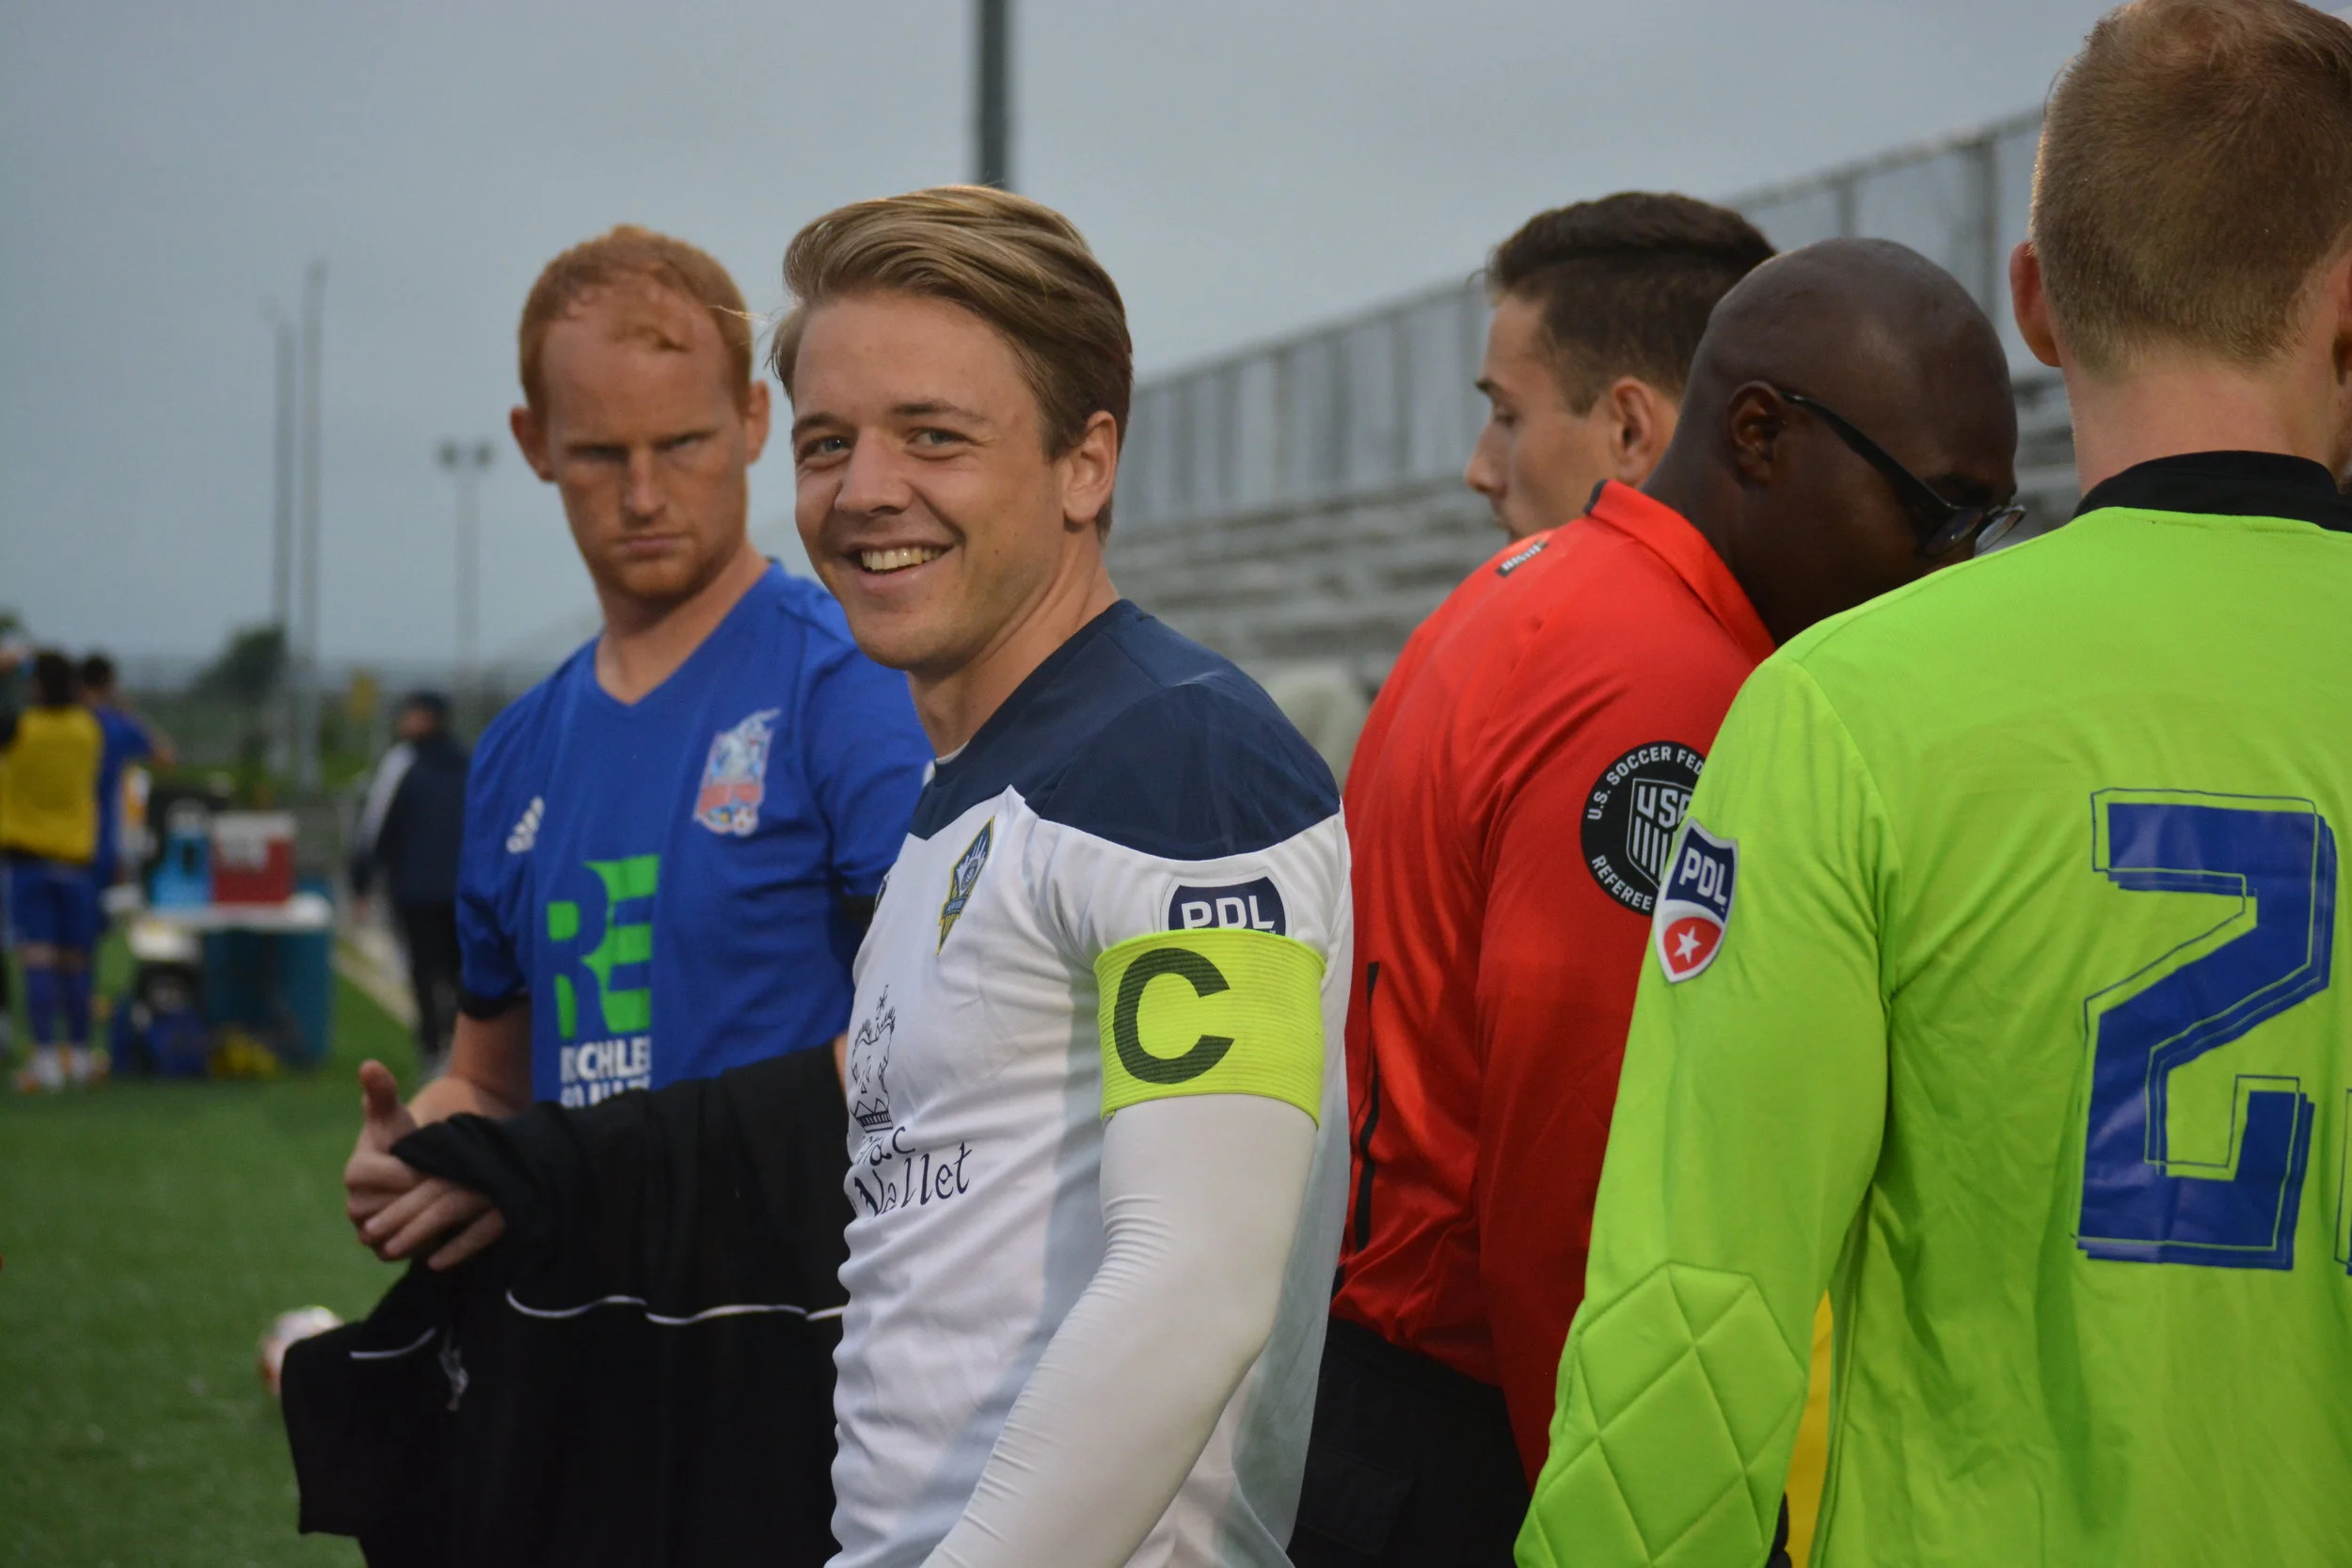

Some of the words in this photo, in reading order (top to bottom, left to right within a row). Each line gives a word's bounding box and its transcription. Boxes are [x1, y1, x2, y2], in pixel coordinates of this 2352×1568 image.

[1587, 788, 1612, 821] U.S.
[1606, 745, 1672, 786] SOCCER
[1592, 854, 1653, 911] REFEREE
[1679, 847, 1727, 905] PDL
[1181, 894, 1275, 929] PDL
[1113, 947, 1234, 1085] C
[2070, 787, 2352, 1275] 2
